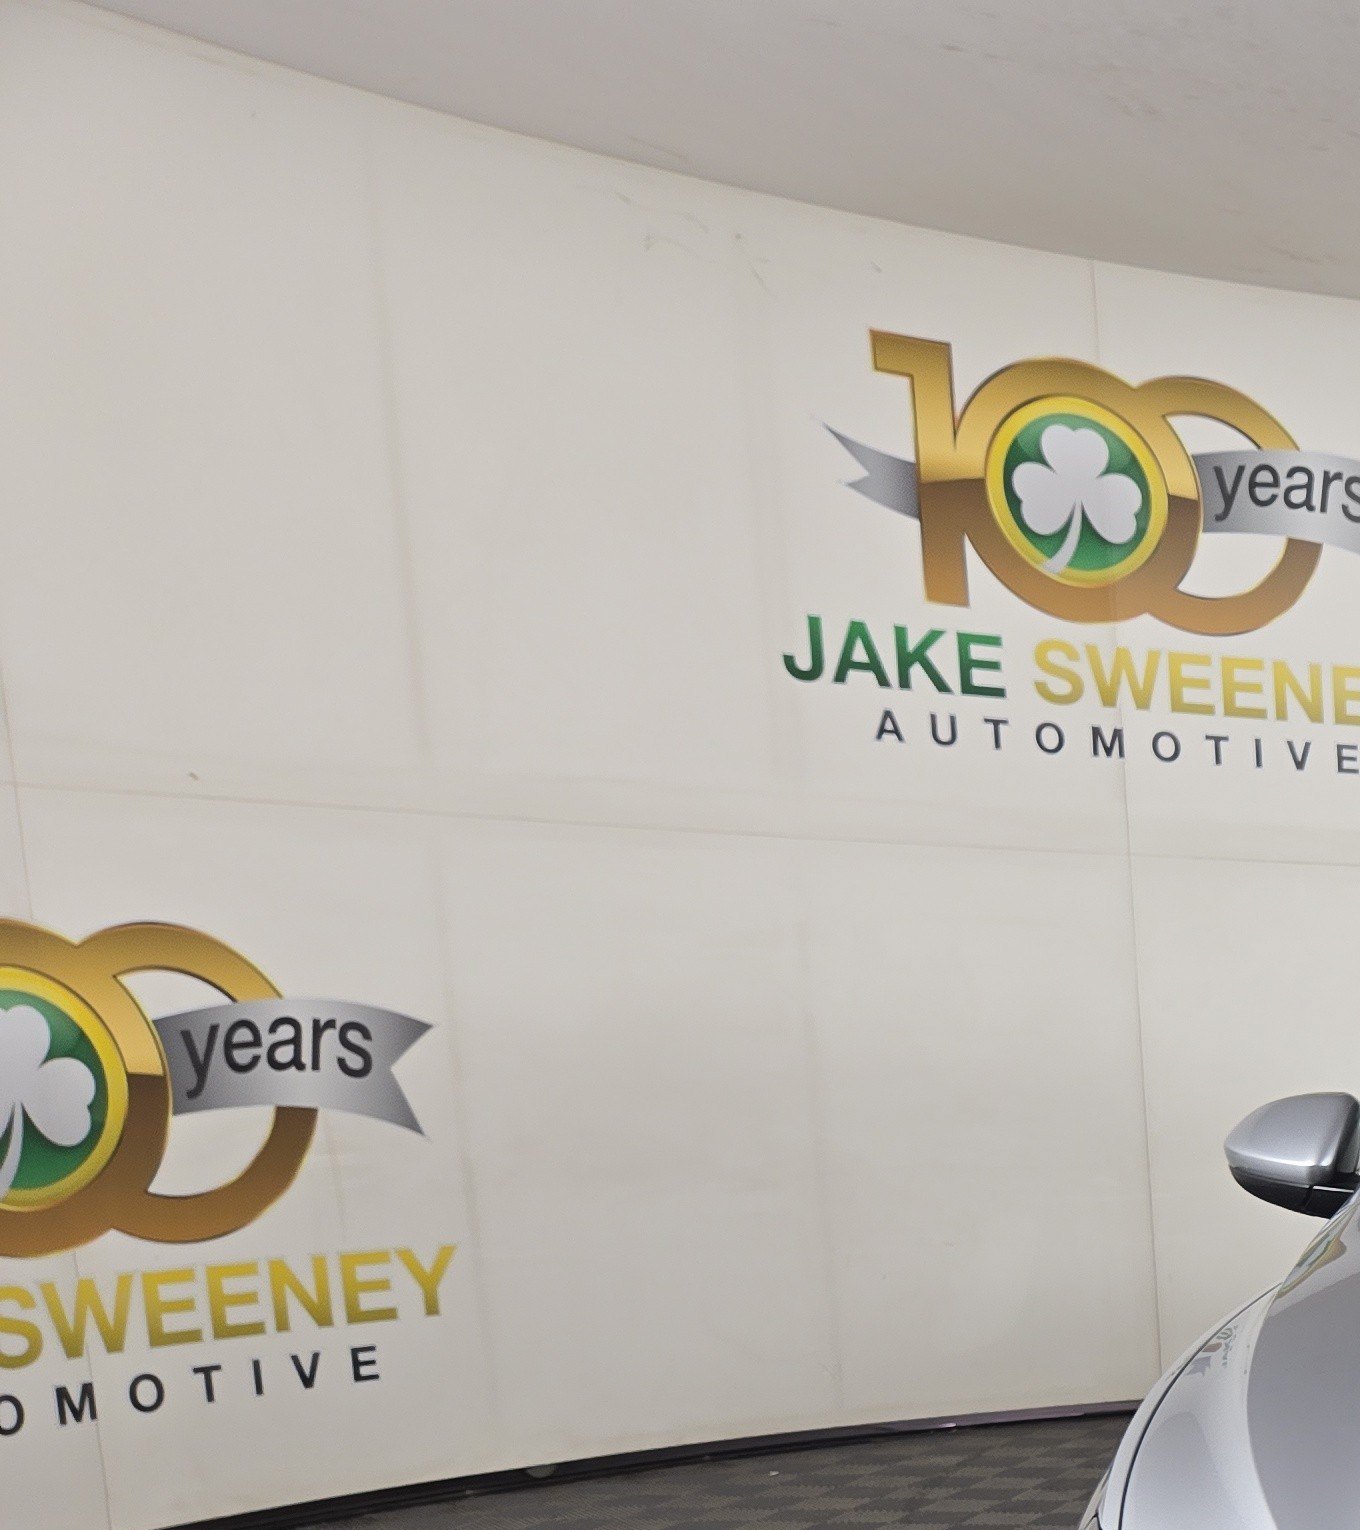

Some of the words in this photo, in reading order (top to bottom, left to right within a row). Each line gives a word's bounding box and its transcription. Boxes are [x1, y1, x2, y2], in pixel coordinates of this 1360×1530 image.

[868, 328, 1323, 637] 100
[782, 614, 1007, 699] JAKE
[875, 708, 1360, 775] AUTOMOTIVE
[180, 1016, 373, 1099] years
